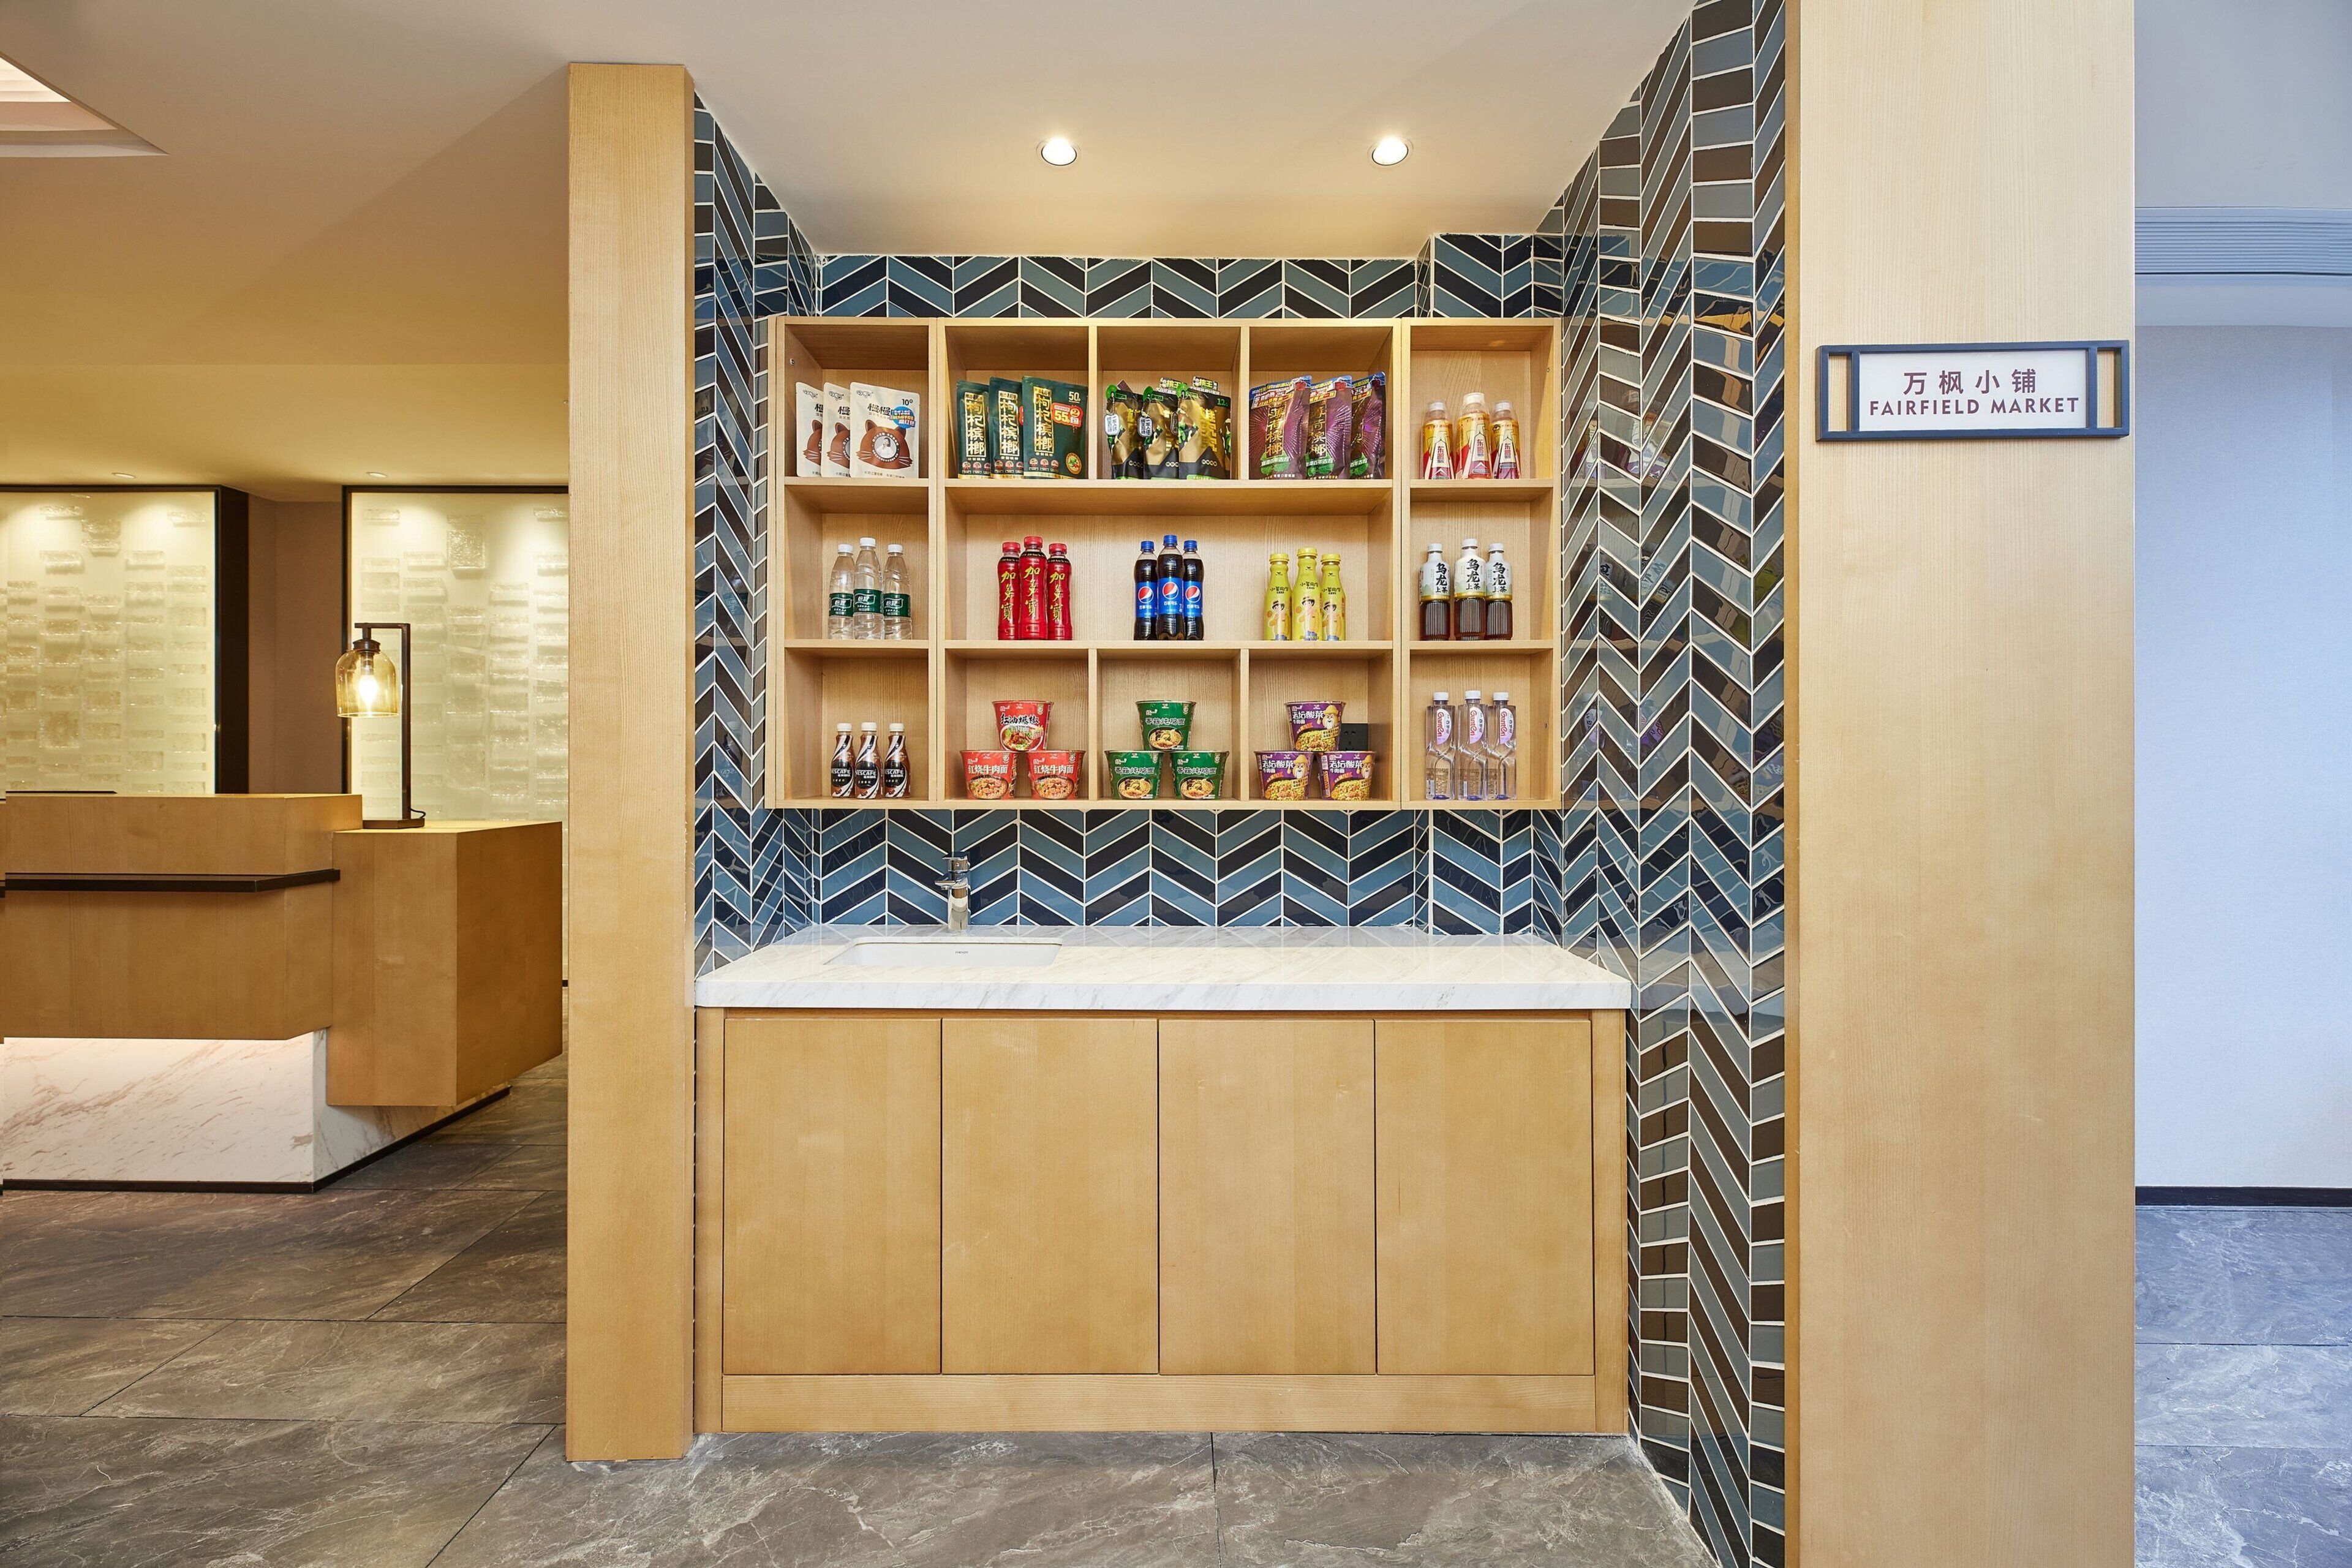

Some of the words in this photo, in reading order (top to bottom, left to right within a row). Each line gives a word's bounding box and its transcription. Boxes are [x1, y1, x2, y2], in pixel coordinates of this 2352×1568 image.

[1903, 369, 2036, 394] 万枫小铺
[1870, 399, 1979, 416] FAIRFIELD
[1991, 397, 2079, 413] MARKET
[967, 401, 985, 455] 枸杞槟榔
[1000, 399, 1018, 454] 枸杞槟榔
[1436, 562, 1447, 586] 乌龙
[1466, 559, 1480, 582] 乌龙
[1493, 562, 1506, 586] 乌龙
[968, 765, 1008, 774] 红烧牛肉面
[1034, 765, 1074, 774] 红烧牛肉面
